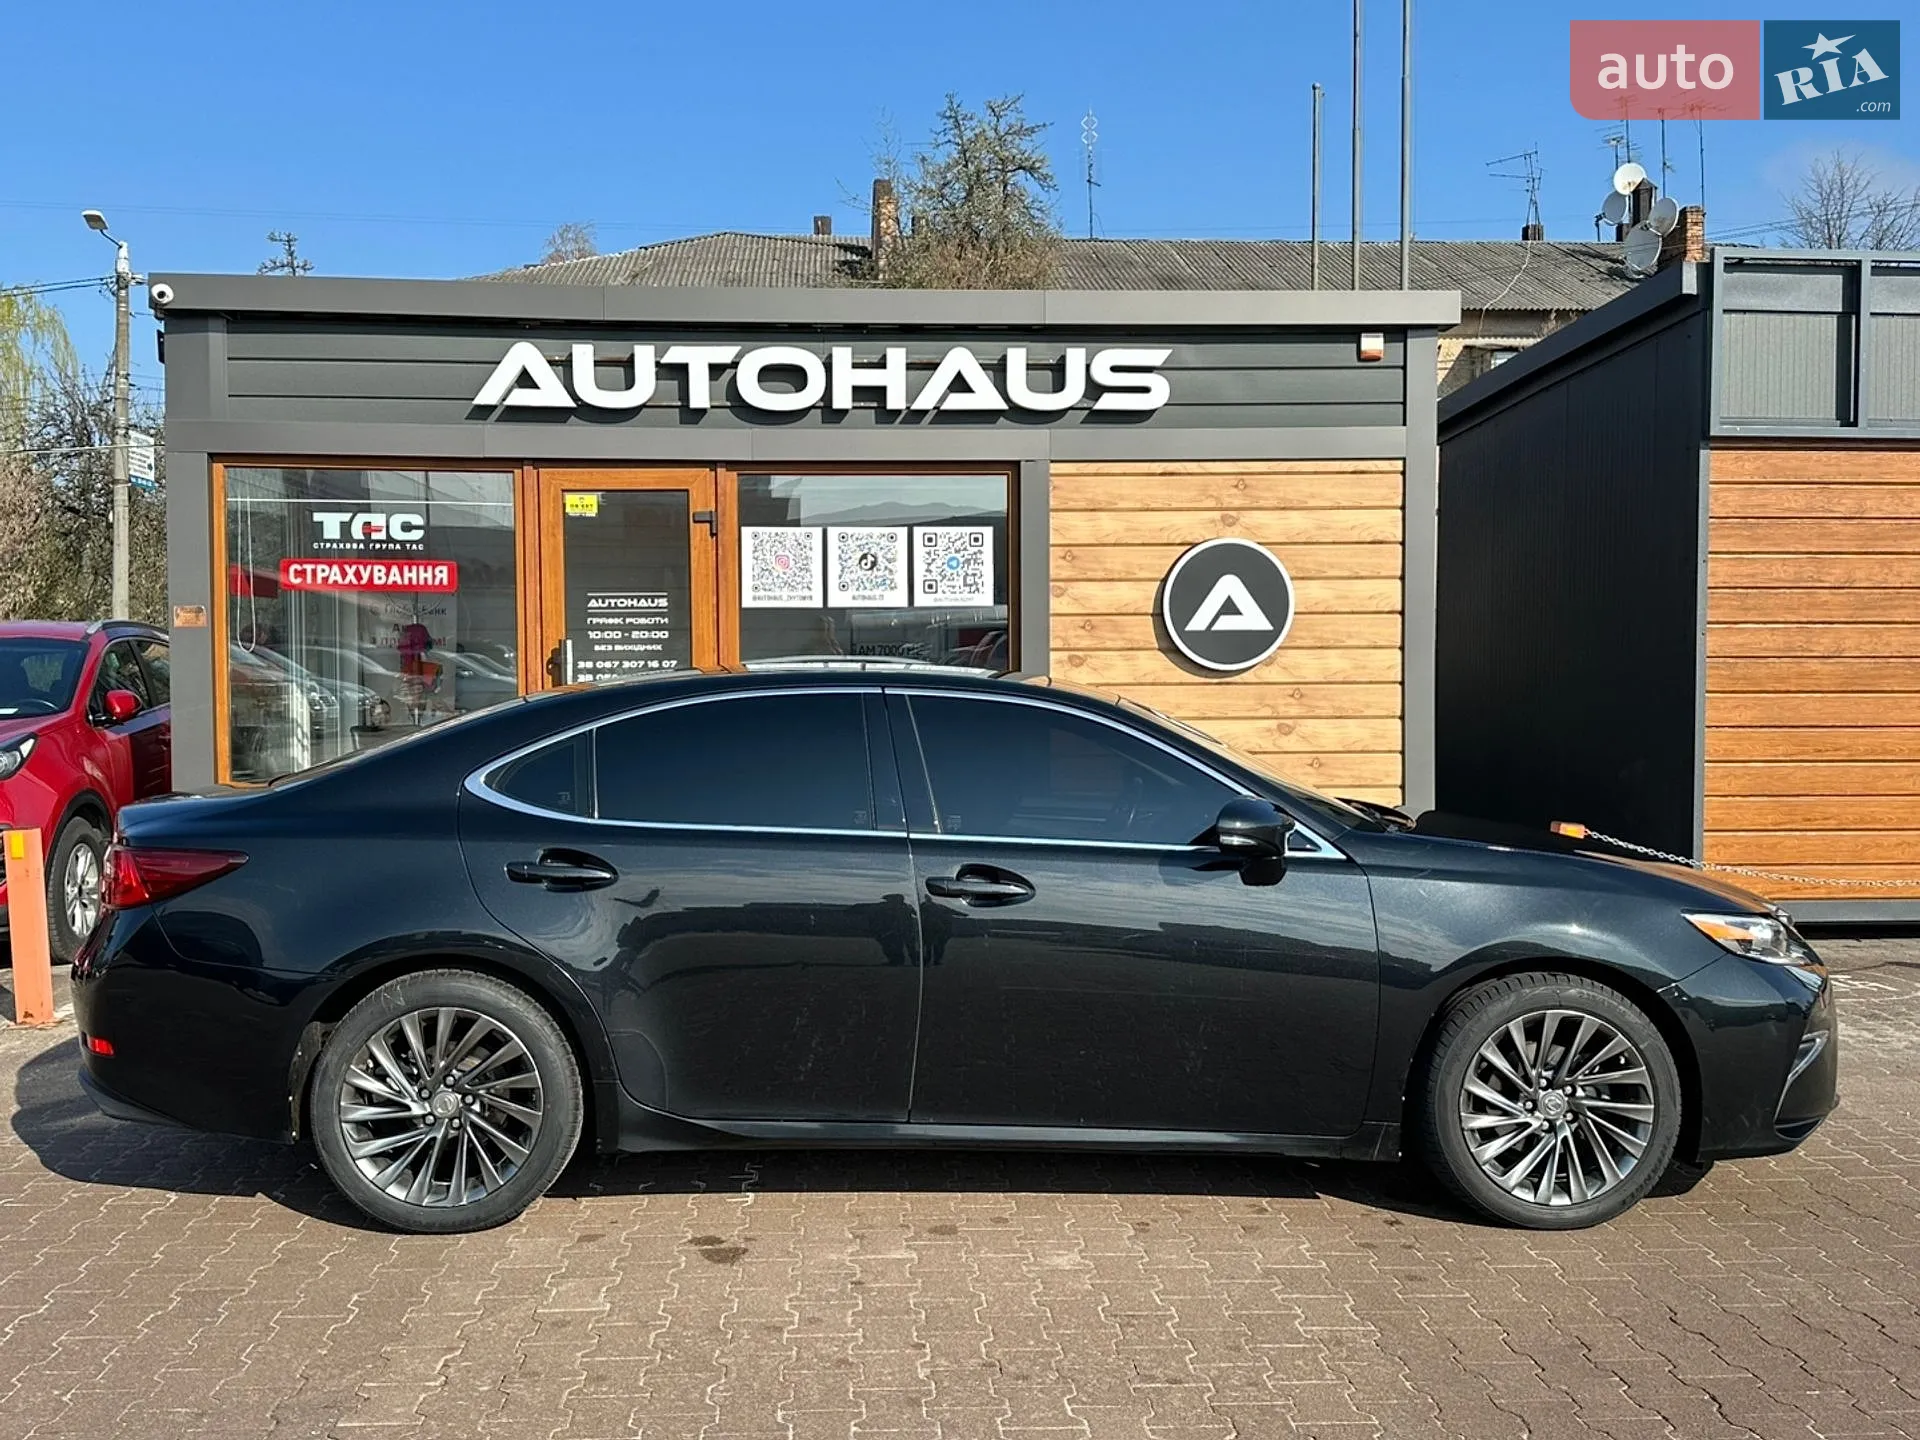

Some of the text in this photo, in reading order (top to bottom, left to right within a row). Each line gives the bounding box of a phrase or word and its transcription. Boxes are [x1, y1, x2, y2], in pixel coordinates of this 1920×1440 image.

[472, 341, 1173, 411] AUTOHAUS
[288, 563, 449, 586] СТРАХУВАННЯ
[587, 598, 669, 608] AUTOHAUS
[588, 630, 622, 638] 10:00
[631, 630, 668, 638] 20:00
